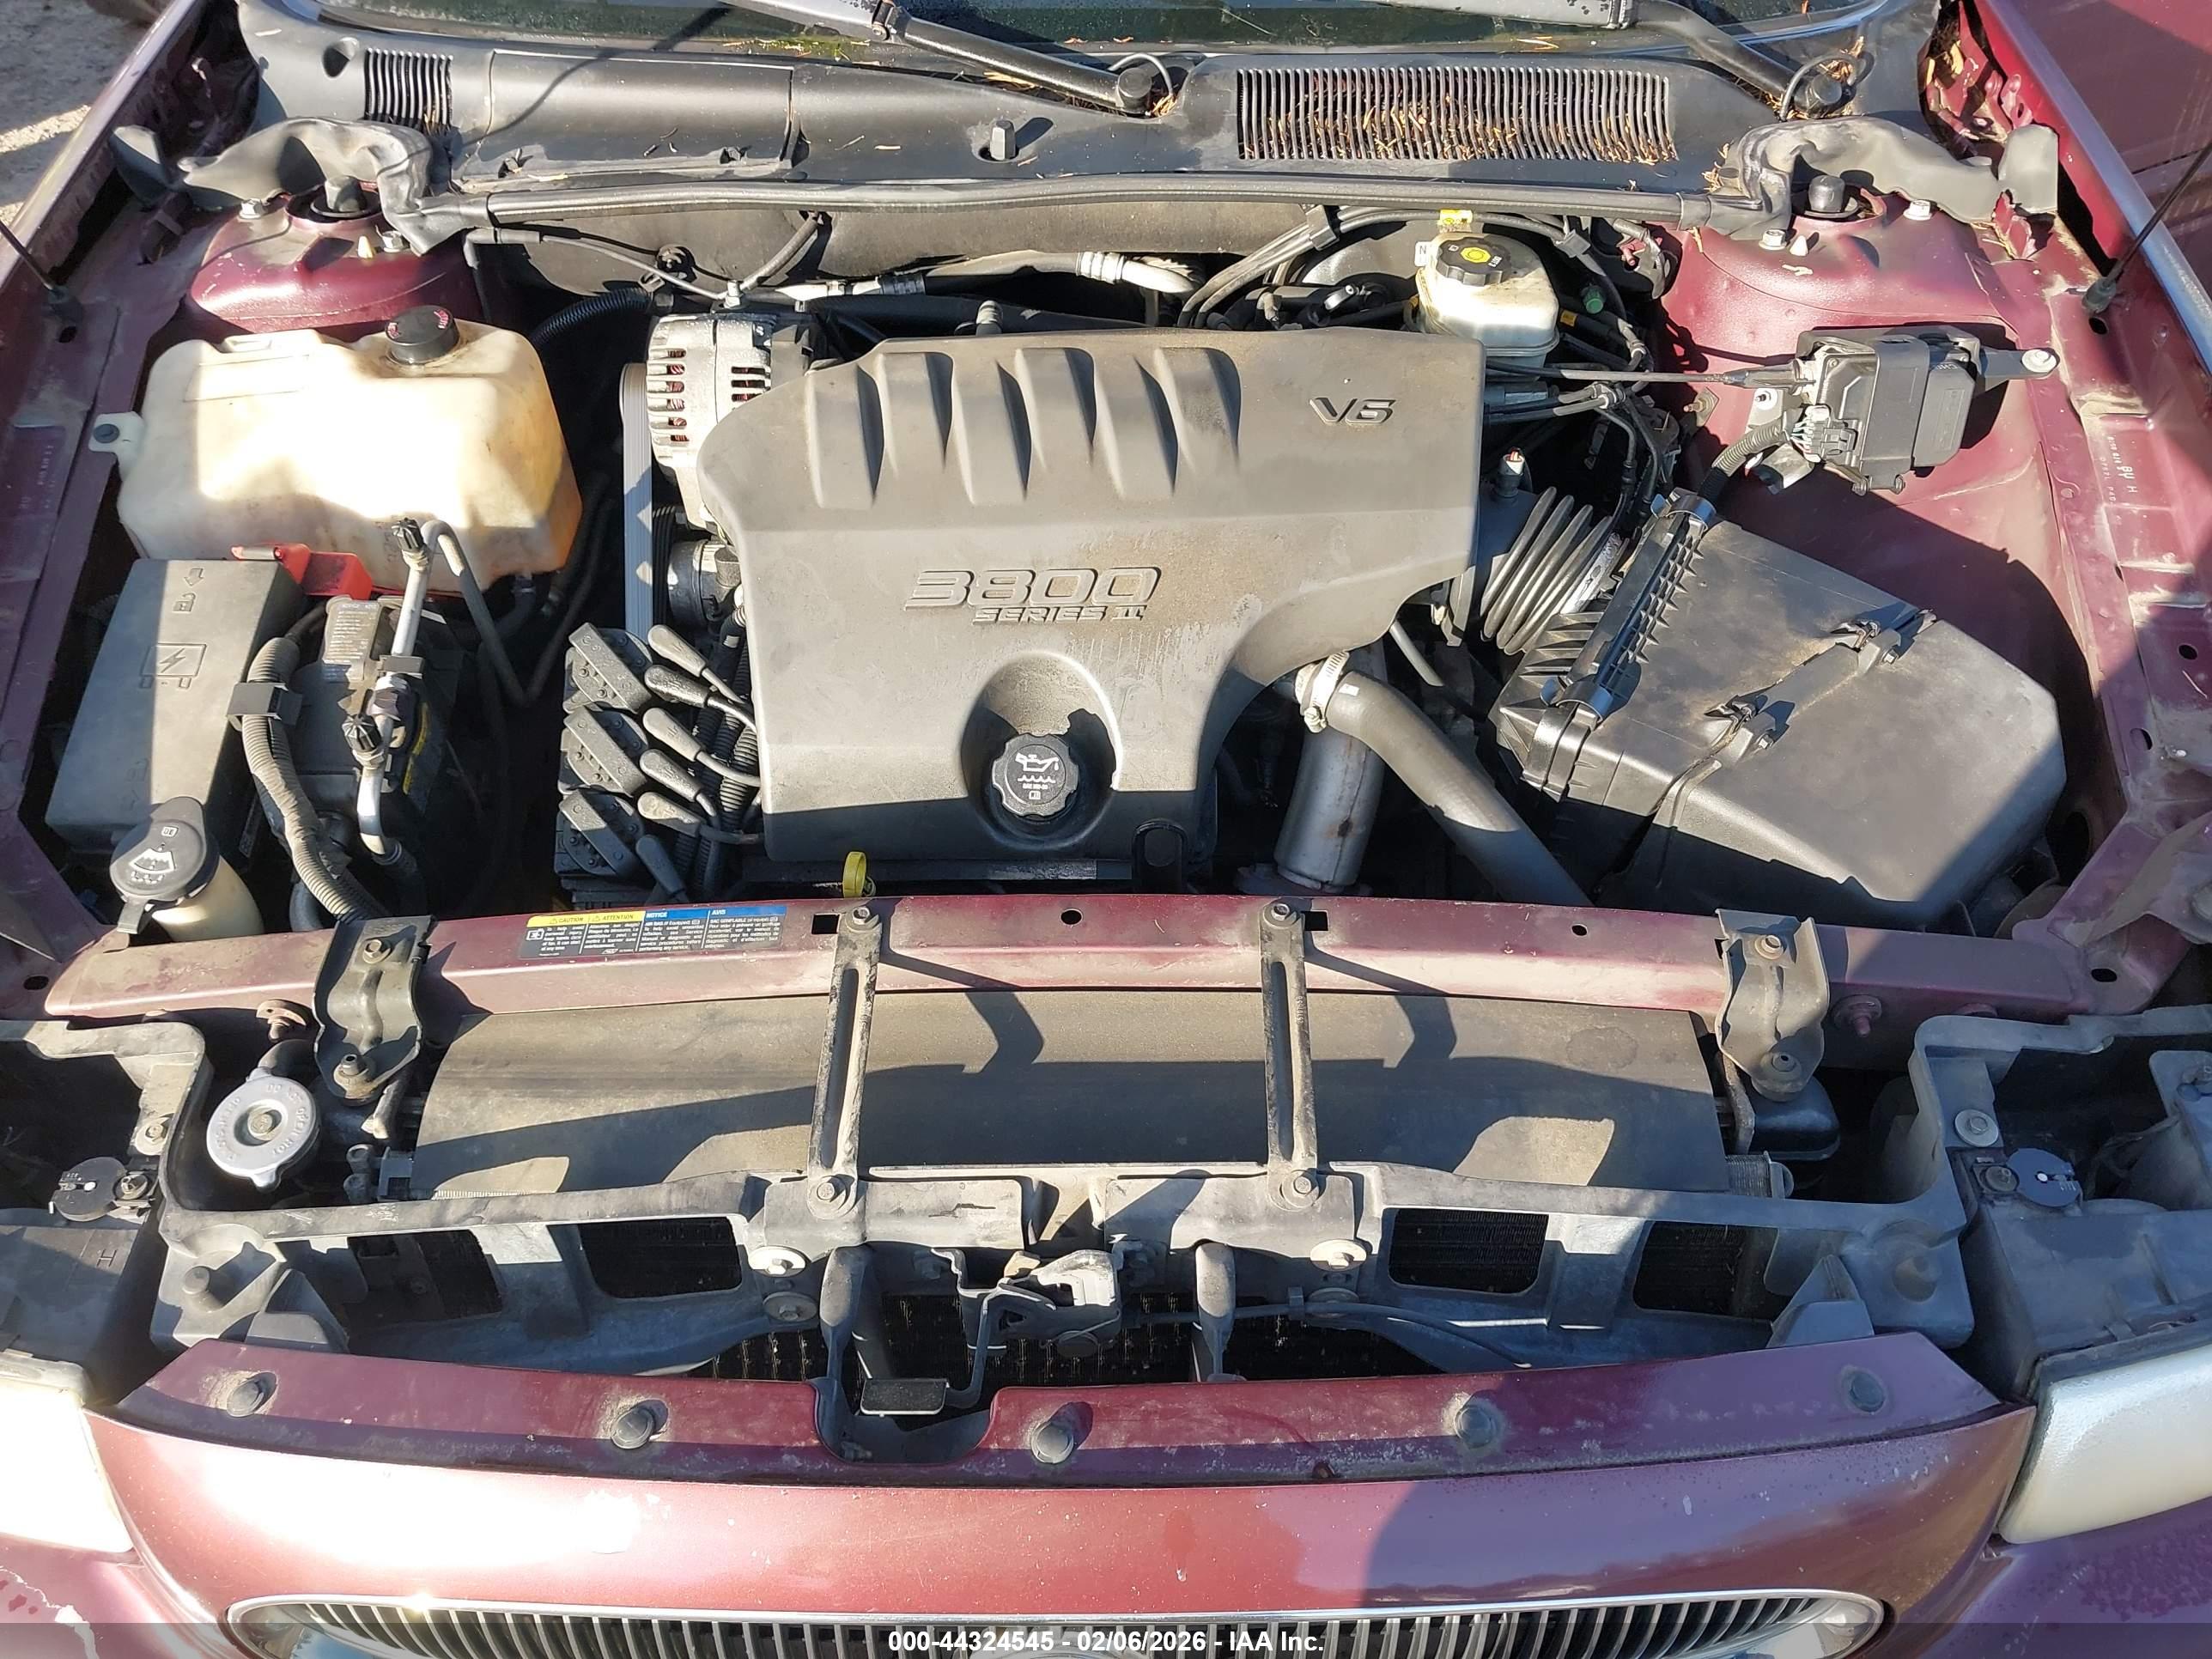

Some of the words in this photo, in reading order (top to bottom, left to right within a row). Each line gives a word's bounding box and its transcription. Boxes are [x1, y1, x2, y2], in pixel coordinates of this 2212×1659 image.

[1309, 397, 1396, 425] V6
[903, 567, 1163, 611] 3800
[972, 605, 1108, 625] SERIES
